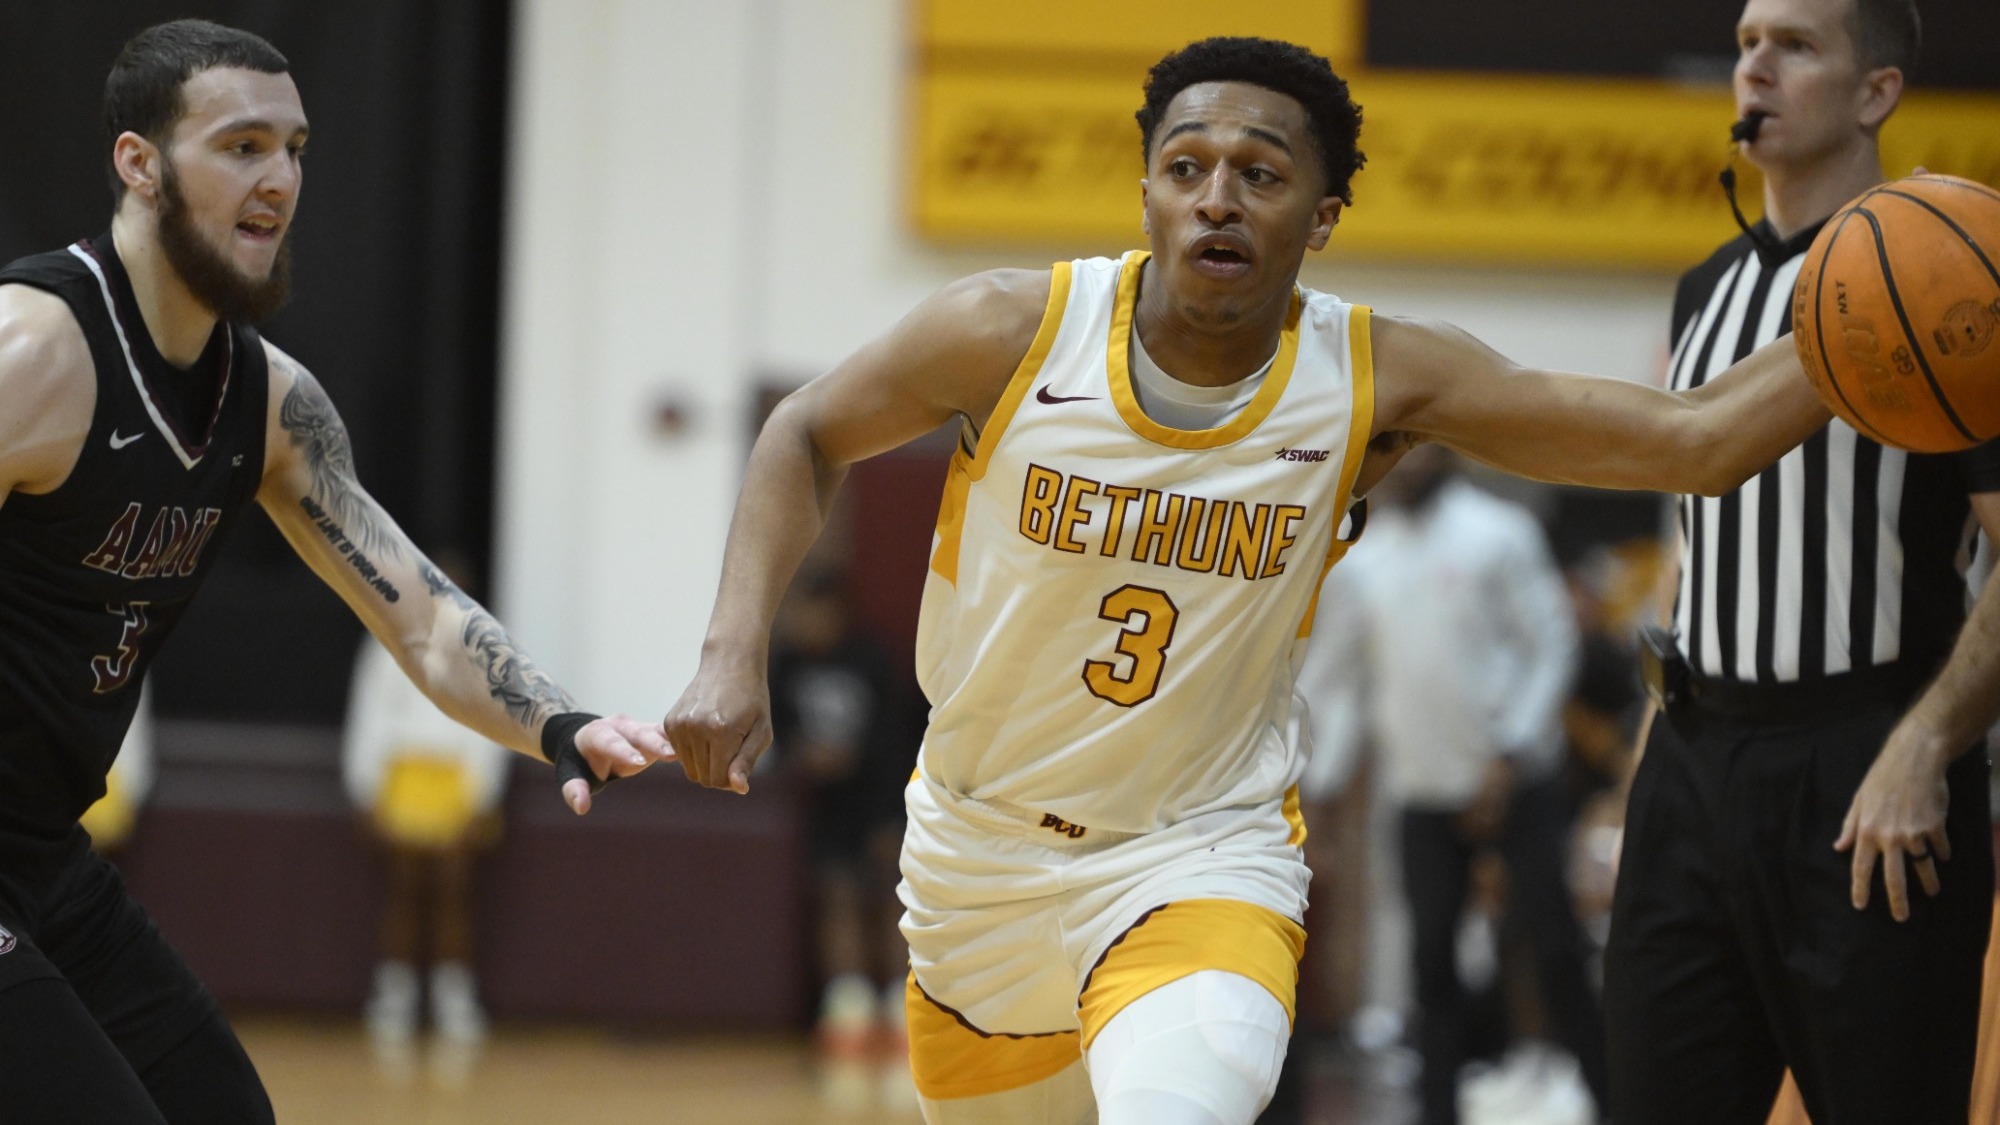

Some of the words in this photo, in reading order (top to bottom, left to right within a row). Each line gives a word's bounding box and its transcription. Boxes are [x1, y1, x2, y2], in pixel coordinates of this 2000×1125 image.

[1835, 280, 1849, 314] NXT
[1288, 449, 1330, 463] SWAC
[82, 502, 221, 580] AAMU
[1019, 463, 1306, 581] BETHUNE
[91, 601, 149, 694] 3
[1081, 583, 1180, 708] 3
